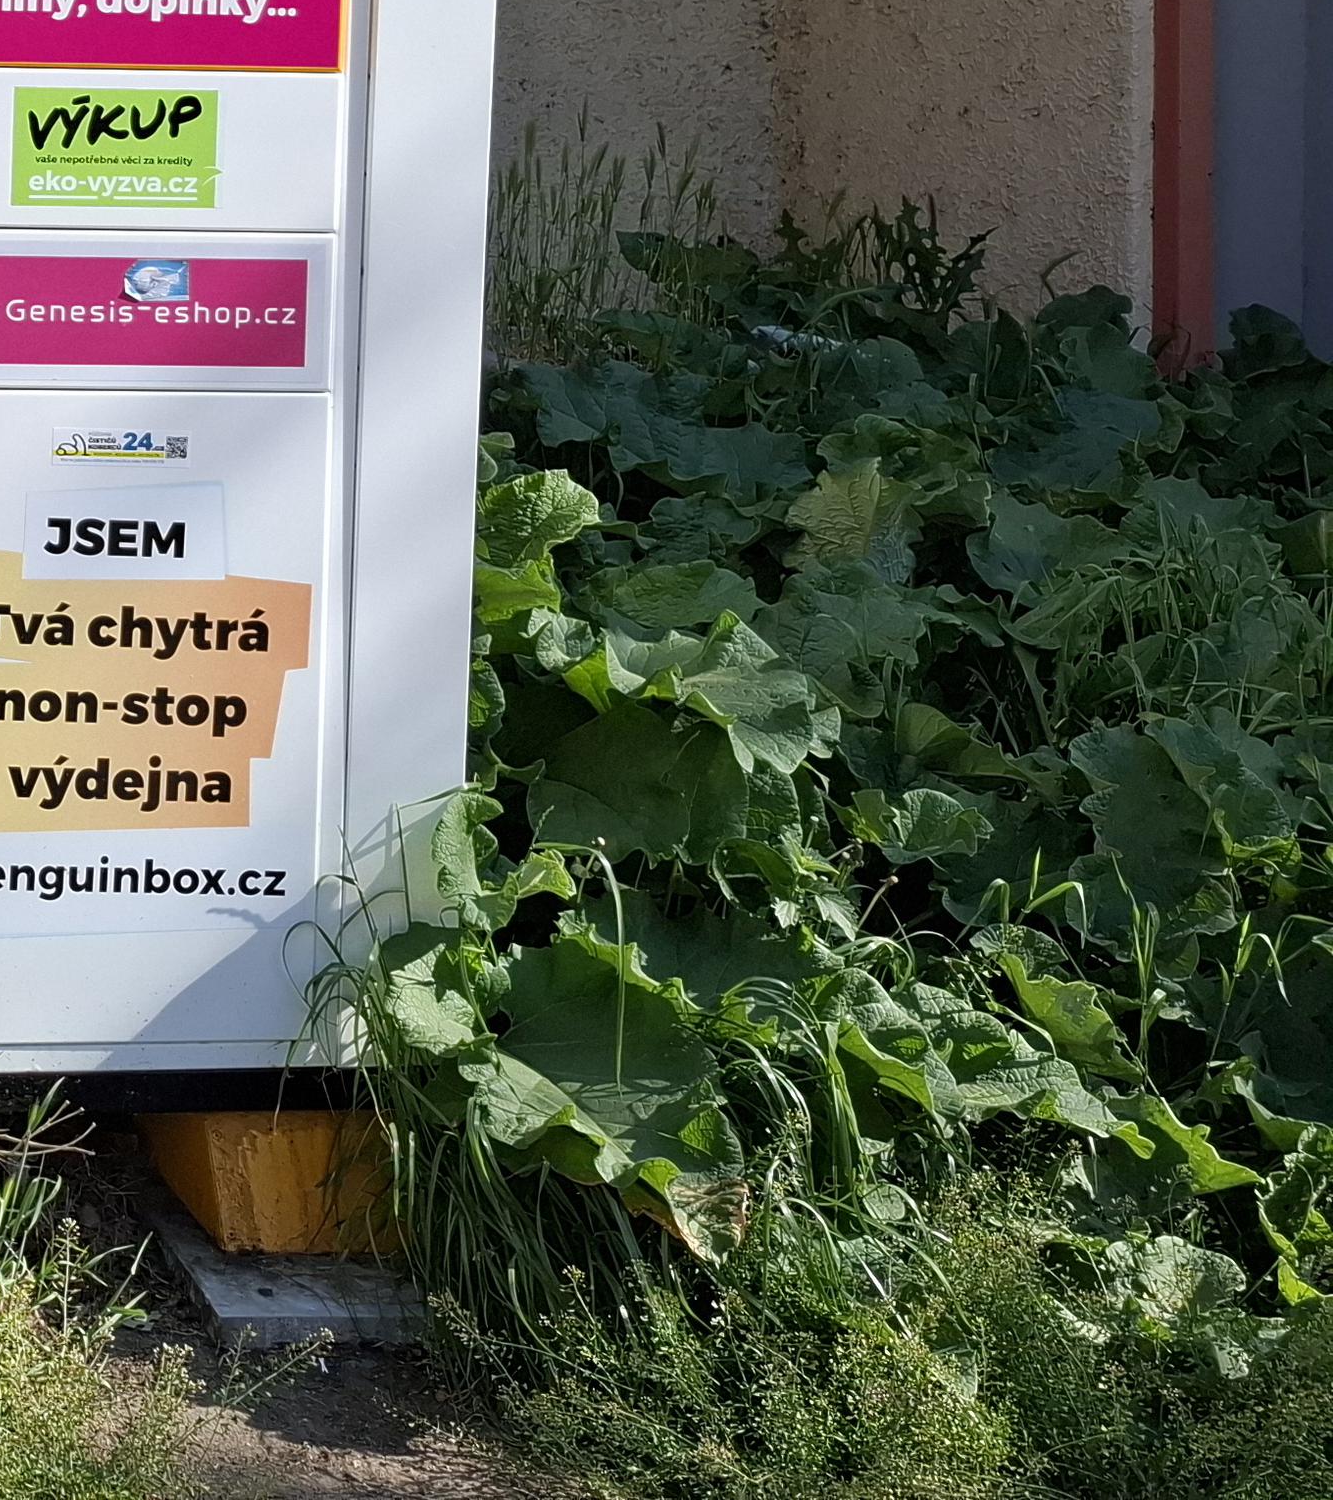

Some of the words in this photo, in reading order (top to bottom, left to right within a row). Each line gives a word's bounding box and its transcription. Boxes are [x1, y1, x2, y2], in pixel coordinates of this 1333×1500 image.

[29, 95, 203, 150] VÝKUP
[35, 155, 57, 164] vaše
[60, 153, 119, 167] nepotřebné
[121, 154, 142, 165] věci
[143, 157, 156, 165] za
[158, 154, 193, 167] kredity
[29, 171, 198, 197] eko-vyzva.cz
[6, 297, 297, 329] Genesis-eshop.cz
[123, 432, 153, 451] 24
[44, 517, 186, 559] JSEM
[87, 604, 270, 660] chytrá
[9, 756, 233, 811] výdejna
